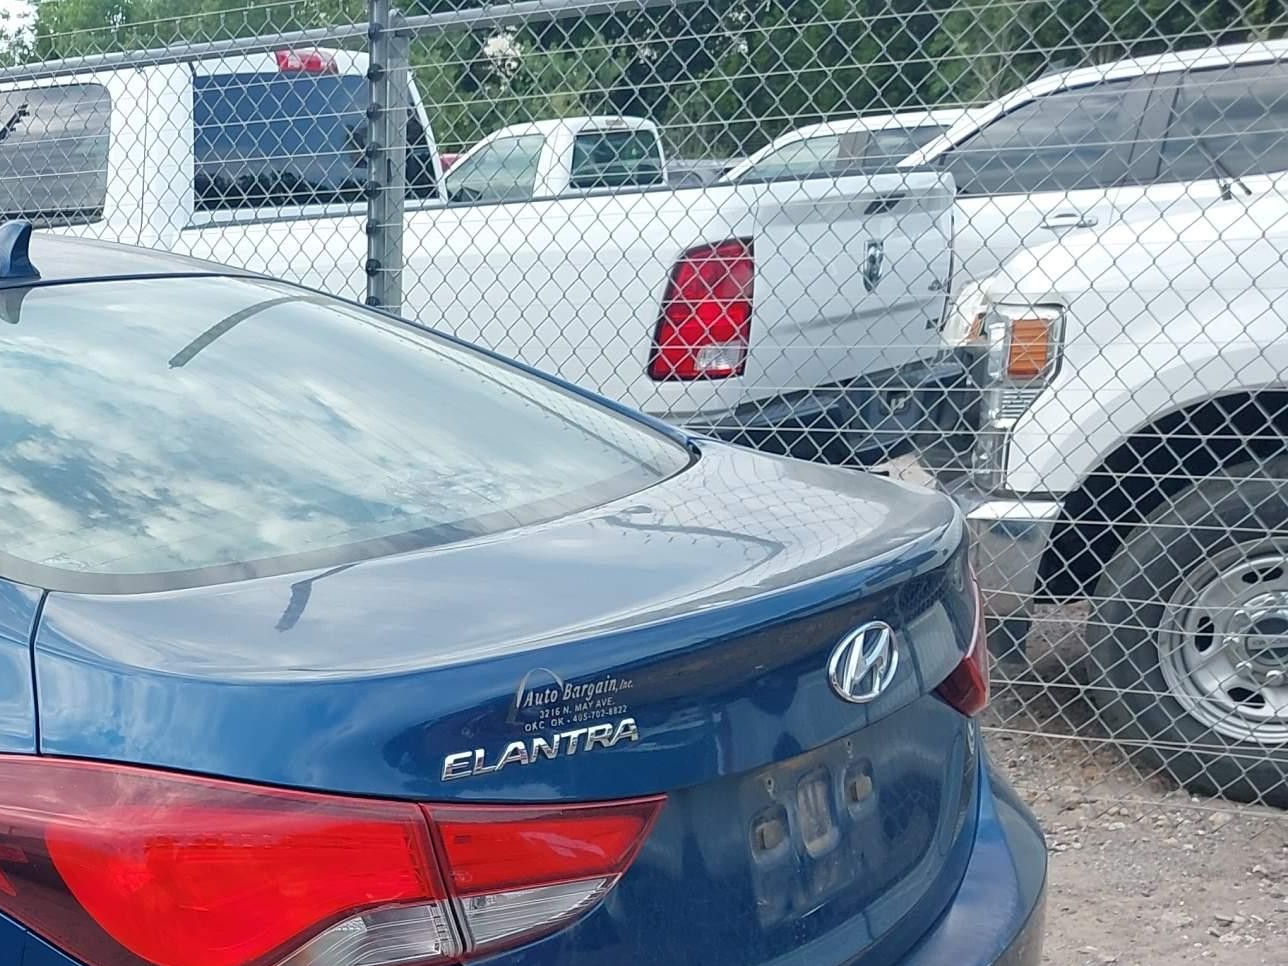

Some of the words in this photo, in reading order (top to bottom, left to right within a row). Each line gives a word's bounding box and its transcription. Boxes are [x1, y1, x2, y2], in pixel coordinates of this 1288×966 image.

[524, 689, 559, 708] Auto
[539, 706, 561, 720] 3216
[574, 701, 594, 712] MAY
[524, 721, 545, 732] OKC
[550, 717, 565, 728] OK
[441, 717, 639, 781] ELANTRA
